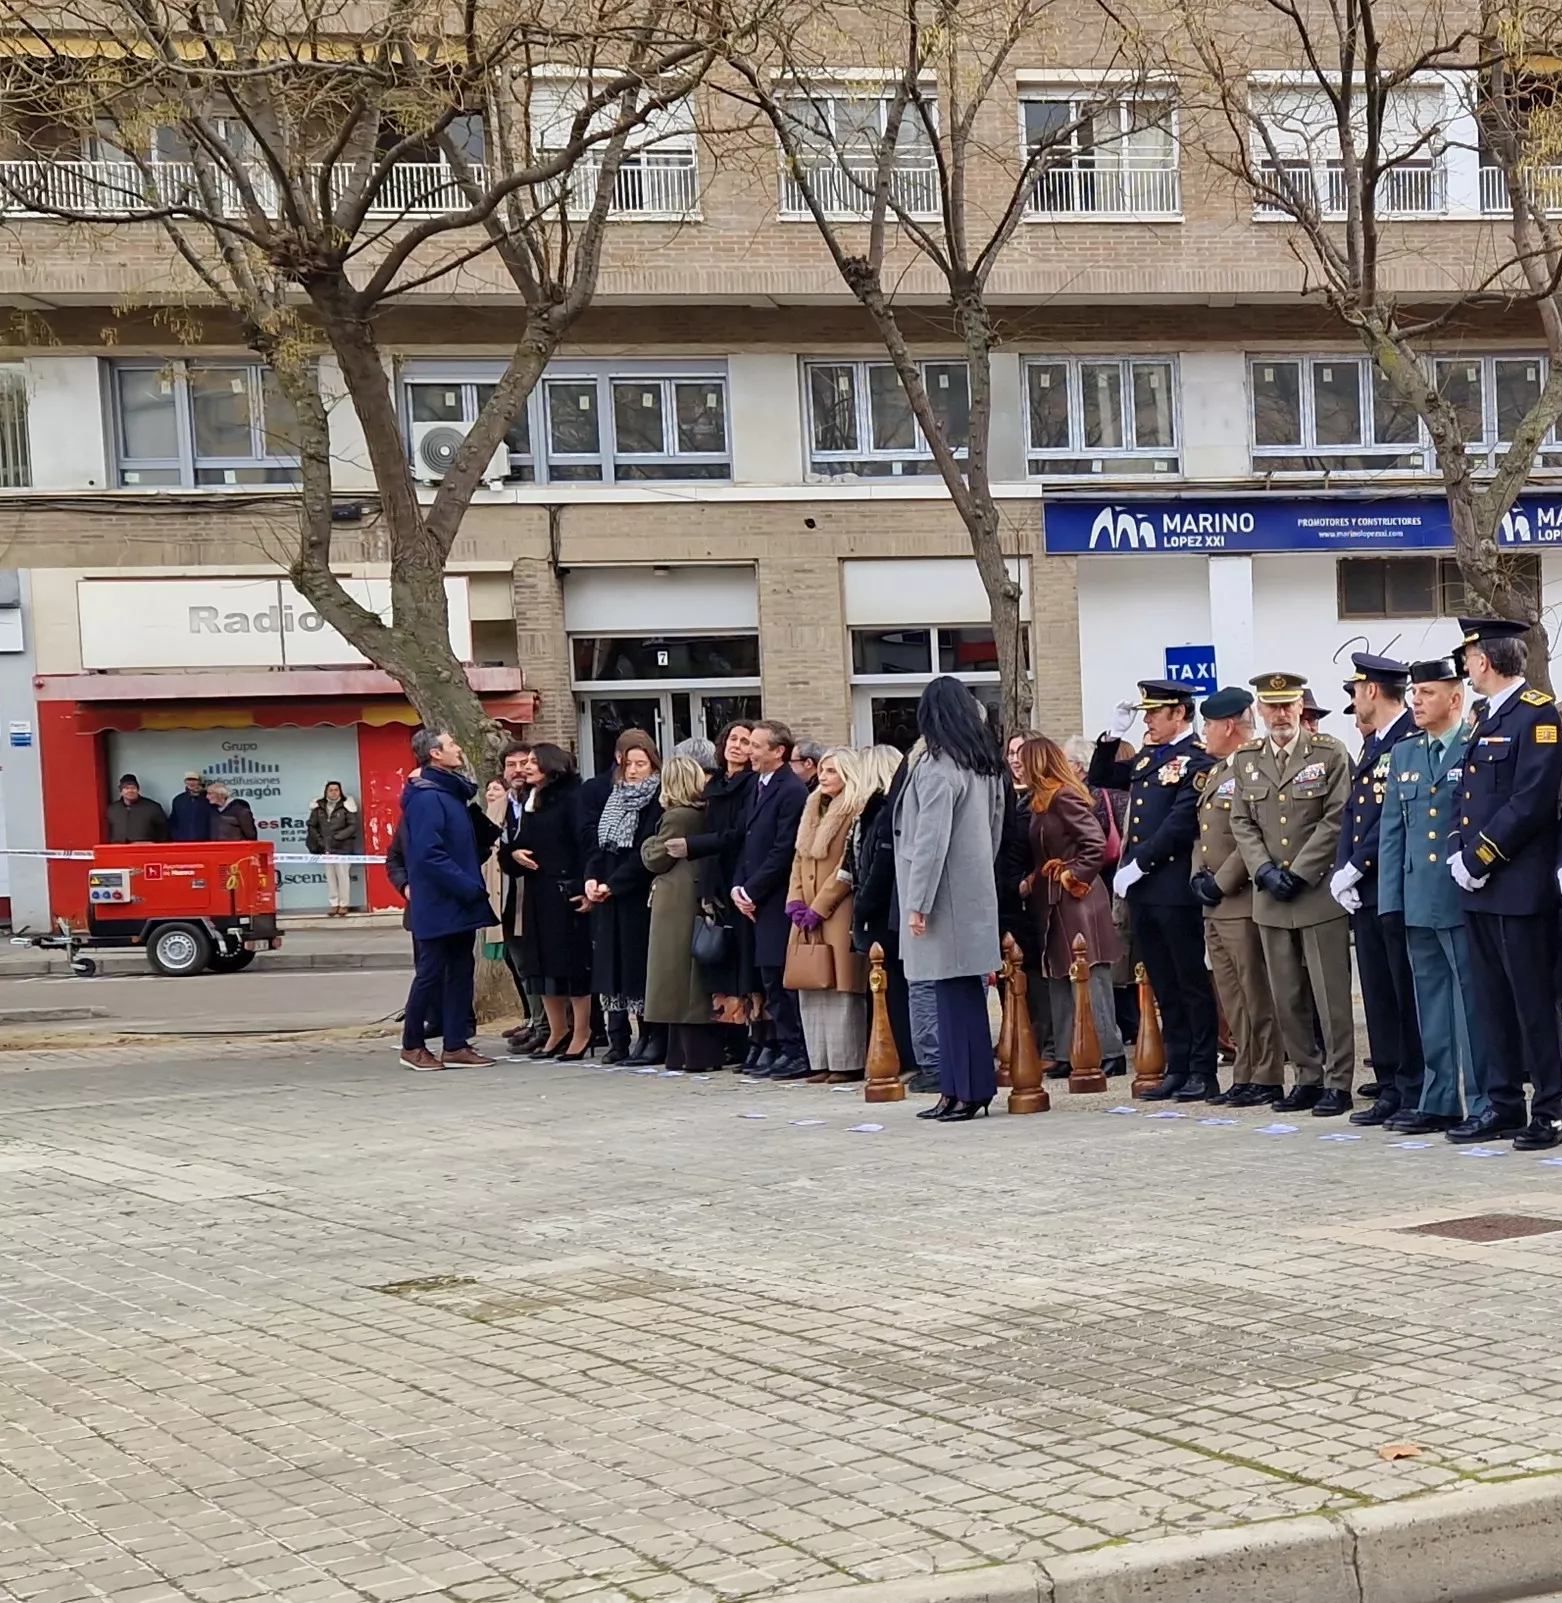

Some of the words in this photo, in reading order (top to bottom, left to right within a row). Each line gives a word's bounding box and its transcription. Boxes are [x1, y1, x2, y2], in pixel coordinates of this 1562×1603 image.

[1163, 513, 1254, 533] MARINO
[1298, 518, 1349, 527] PROMOTORES
[1352, 518, 1356, 526] Y
[1358, 517, 1422, 526] CONSTRUCTORES
[1164, 536, 1203, 548] LOPEZ
[1205, 536, 1225, 547] XXI
[189, 604, 325, 634] Radio
[659, 652, 666, 664] 7
[1167, 662, 1216, 680] TAXI
[222, 741, 257, 751] Grupo
[258, 817, 309, 829] esRa
